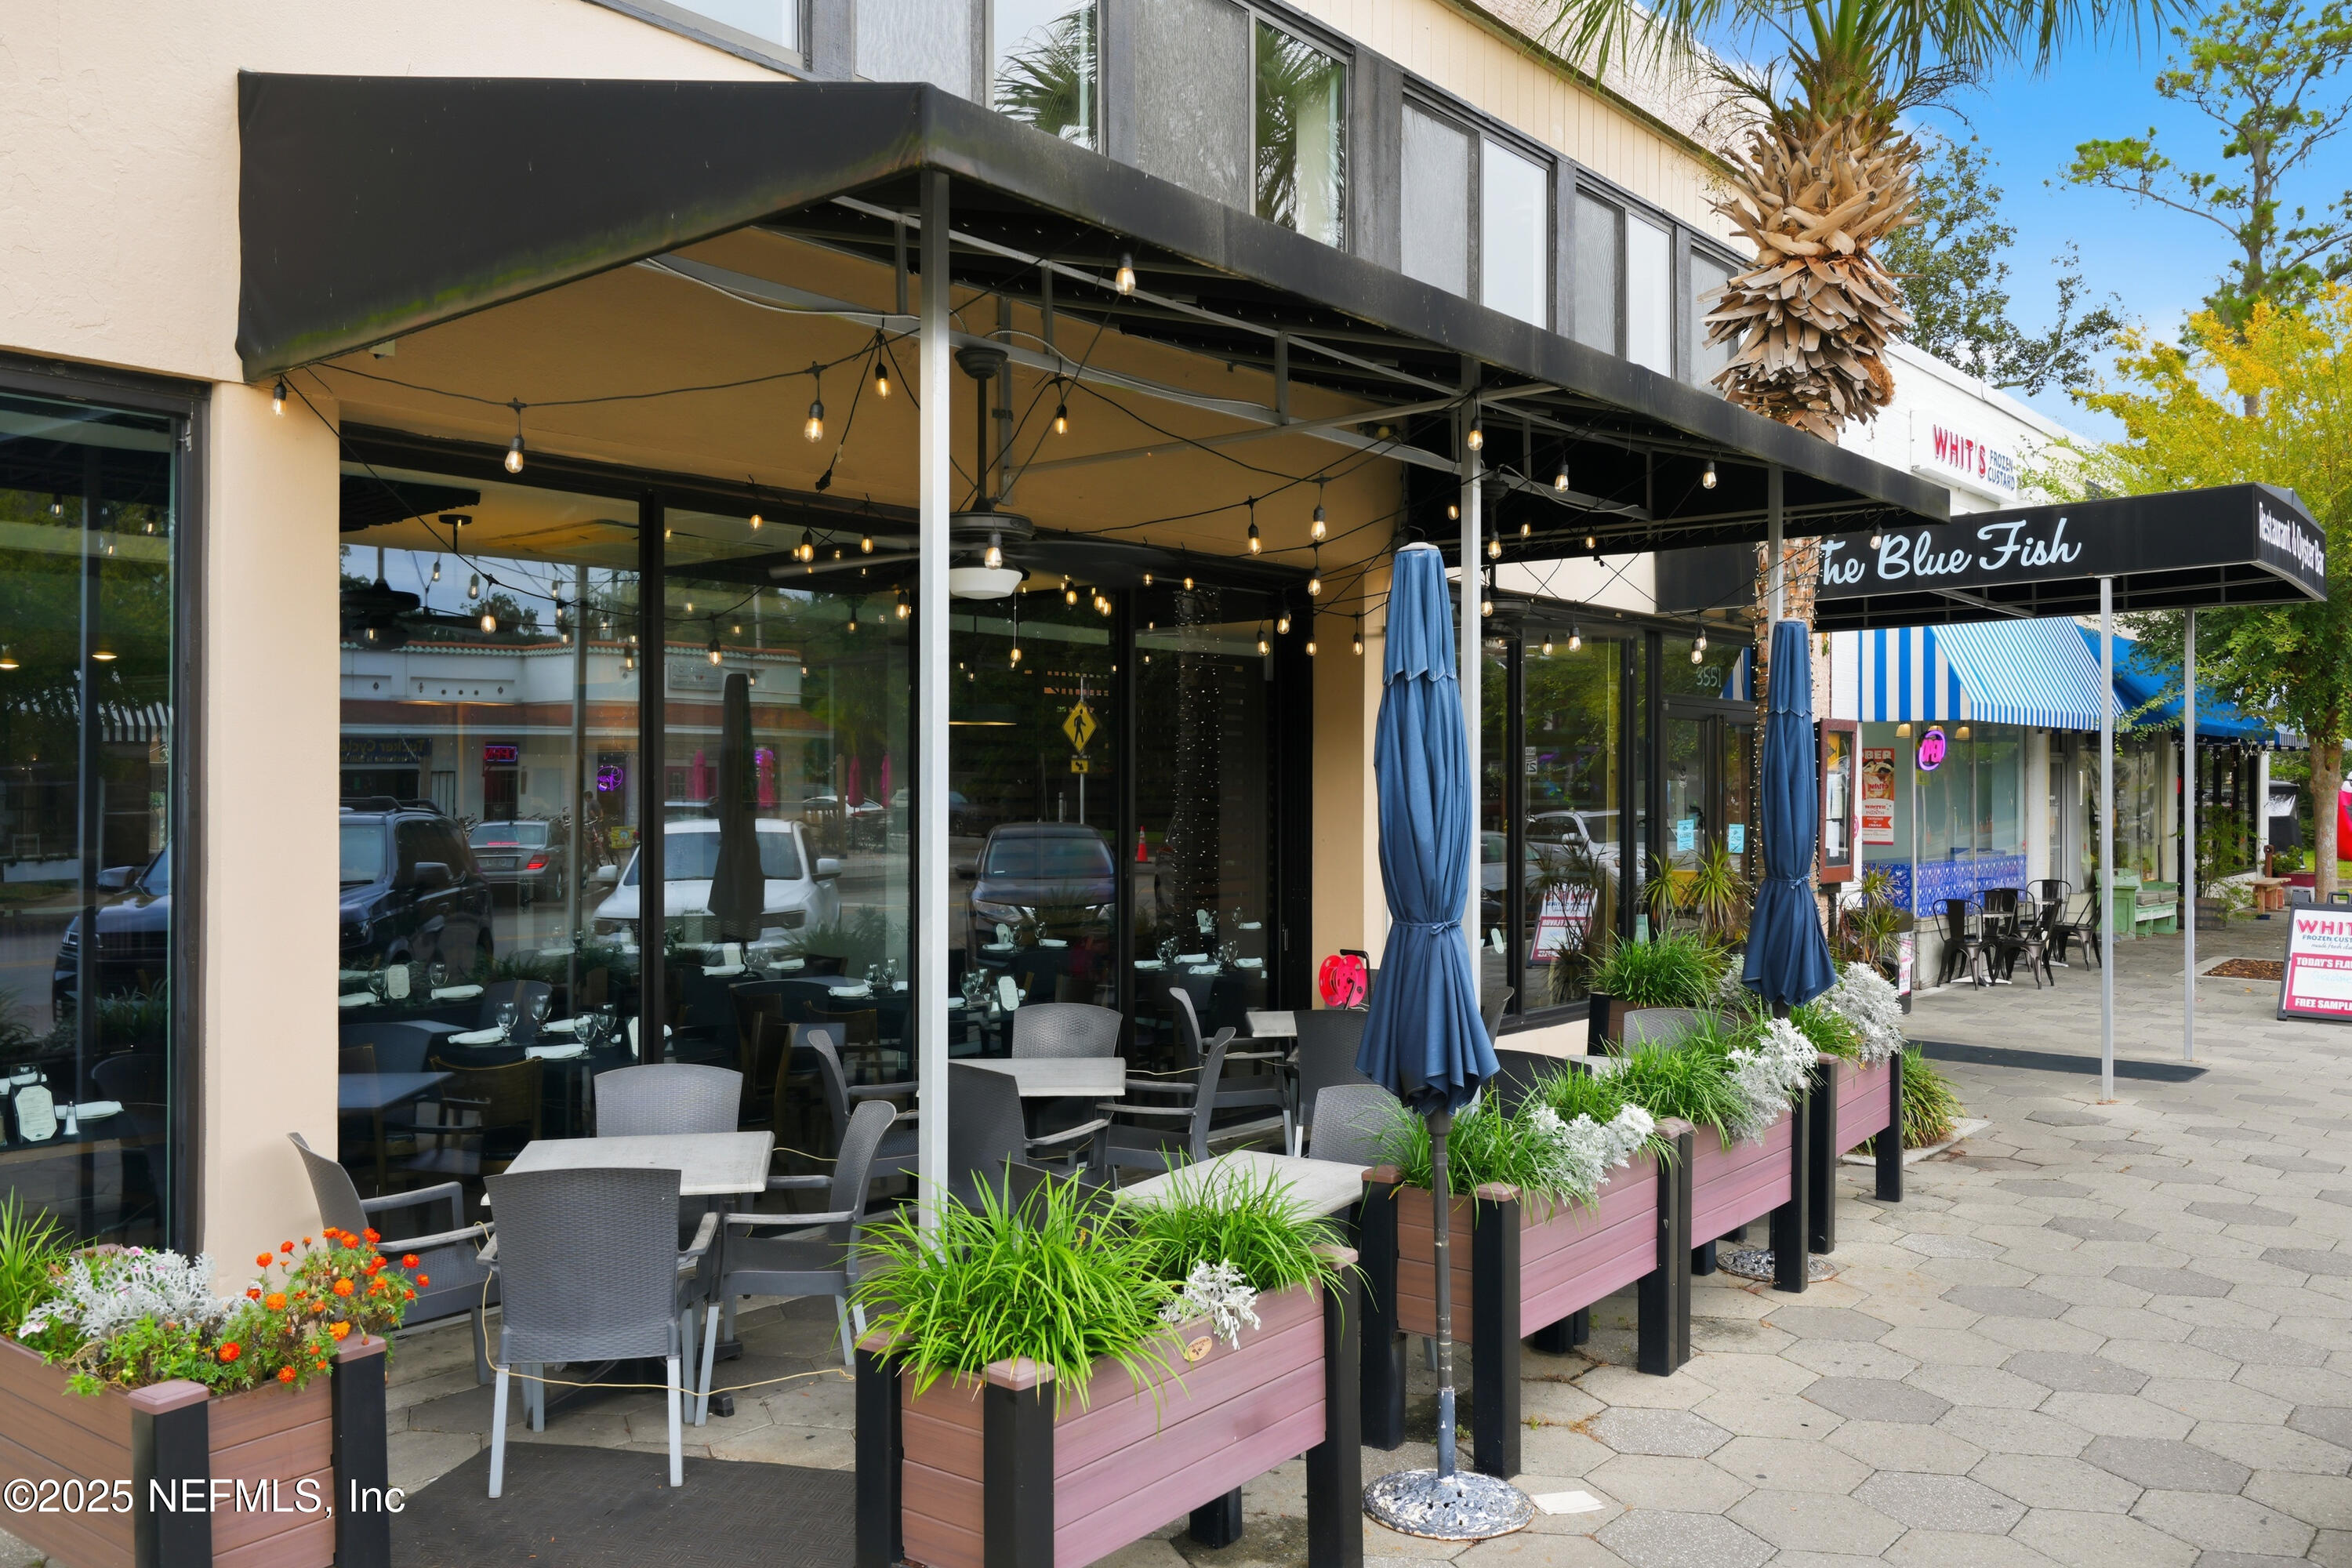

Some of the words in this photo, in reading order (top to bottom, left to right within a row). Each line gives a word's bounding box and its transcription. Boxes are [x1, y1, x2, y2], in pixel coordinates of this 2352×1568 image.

[1933, 423, 1986, 477] WHIT'S
[1989, 449, 2013, 473] FROZEN
[1987, 467, 2016, 491] CUSTARD
[2259, 501, 2292, 554] Restaurant
[2296, 525, 2314, 570] Oyster
[2314, 539, 2325, 577] Bar
[1820, 539, 1865, 586] The
[1877, 530, 1973, 580] Blue
[1976, 517, 2082, 571] Fish
[1696, 666, 1722, 688] 3551
[2296, 956, 2333, 968] TODAY'S
[2335, 959, 2352, 969] FLA
[2295, 997, 2317, 1008] FREE
